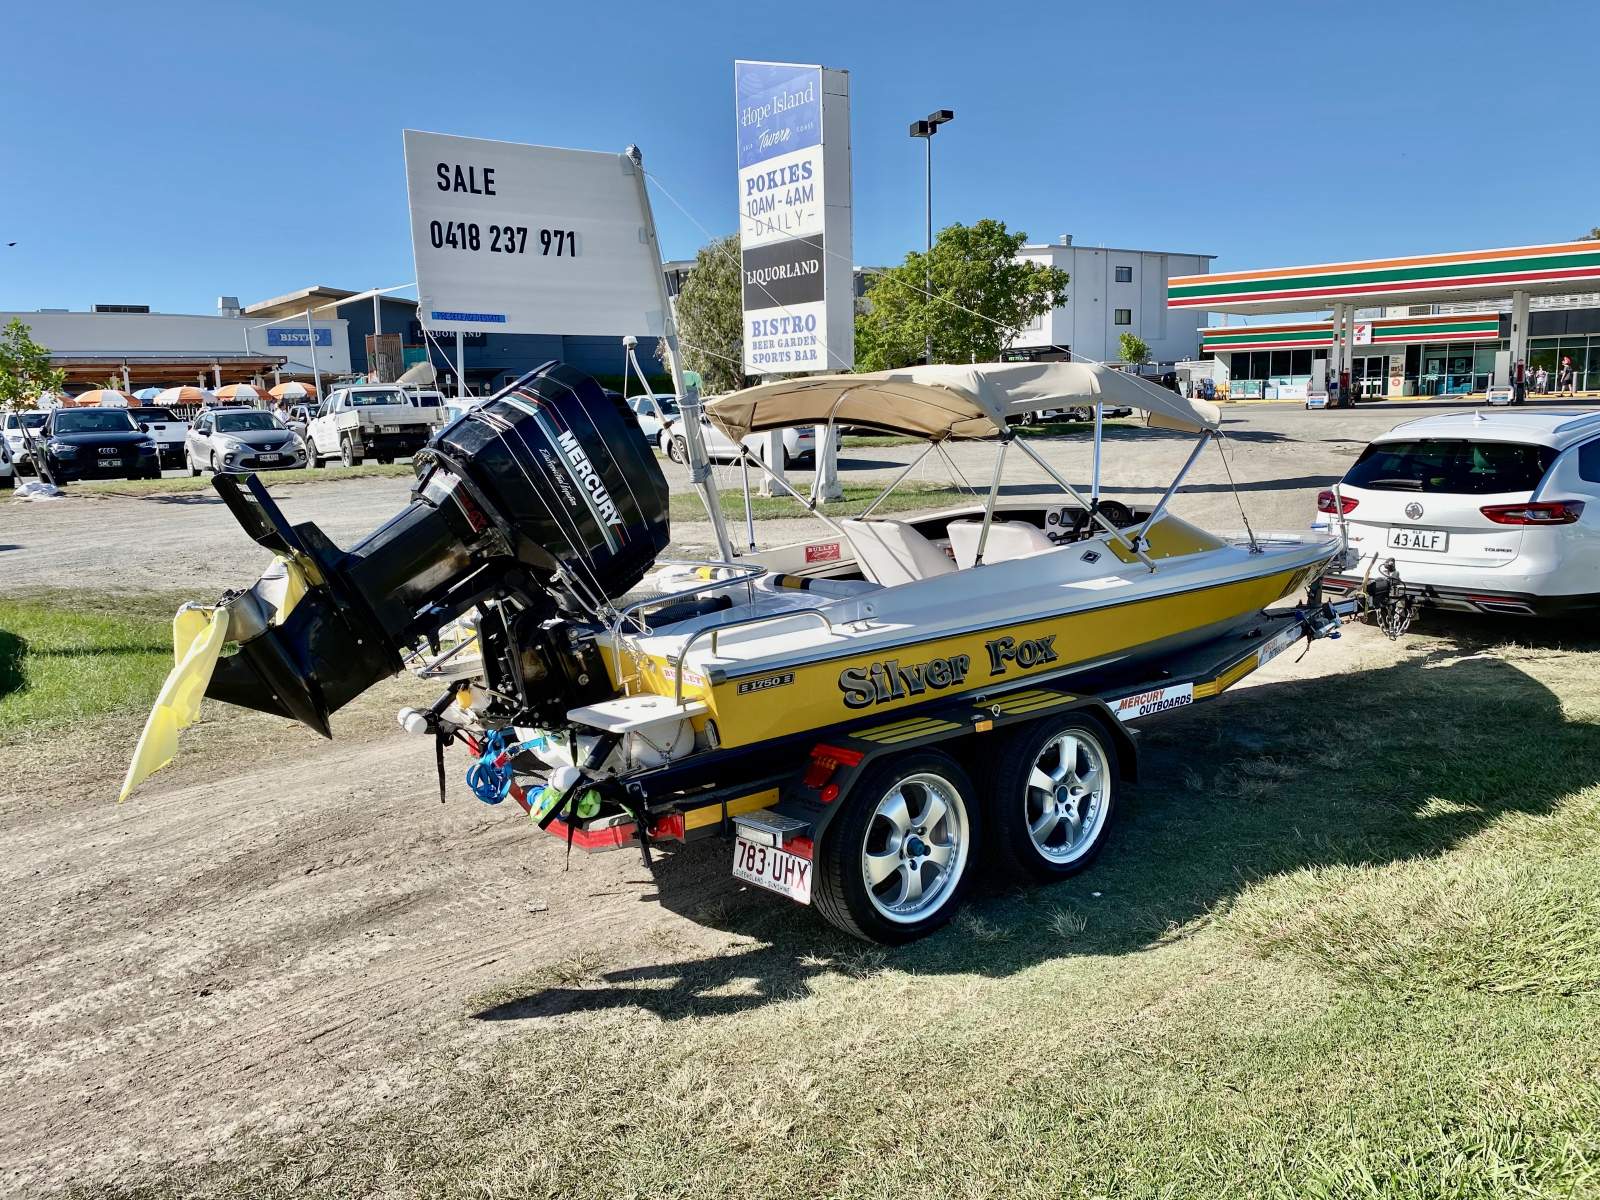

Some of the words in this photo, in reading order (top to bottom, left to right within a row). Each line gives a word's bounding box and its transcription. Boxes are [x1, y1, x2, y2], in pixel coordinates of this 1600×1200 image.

[742, 103, 771, 128] Hope
[773, 81, 814, 115] Island
[758, 127, 792, 153] Tavern
[437, 163, 496, 195] SALE
[746, 160, 813, 196] POKIES
[430, 220, 481, 251] 0418
[489, 225, 528, 254] 237
[540, 229, 576, 257] 971
[747, 259, 819, 285] LIQUORLAND
[417, 330, 481, 339] LQUORAND
[752, 314, 817, 337] BISTRO
[752, 339, 775, 350] BEER
[777, 336, 816, 348] GARDEN
[752, 351, 791, 364] SPORTS
[795, 349, 817, 361] BAR
[557, 430, 622, 527] MERCURY
[808, 544, 837, 552] BULLET
[838, 653, 970, 709] Silver
[985, 634, 1059, 676] Fox
[1119, 689, 1165, 710] MERCURY
[1139, 694, 1192, 715] OUTBOARDS
